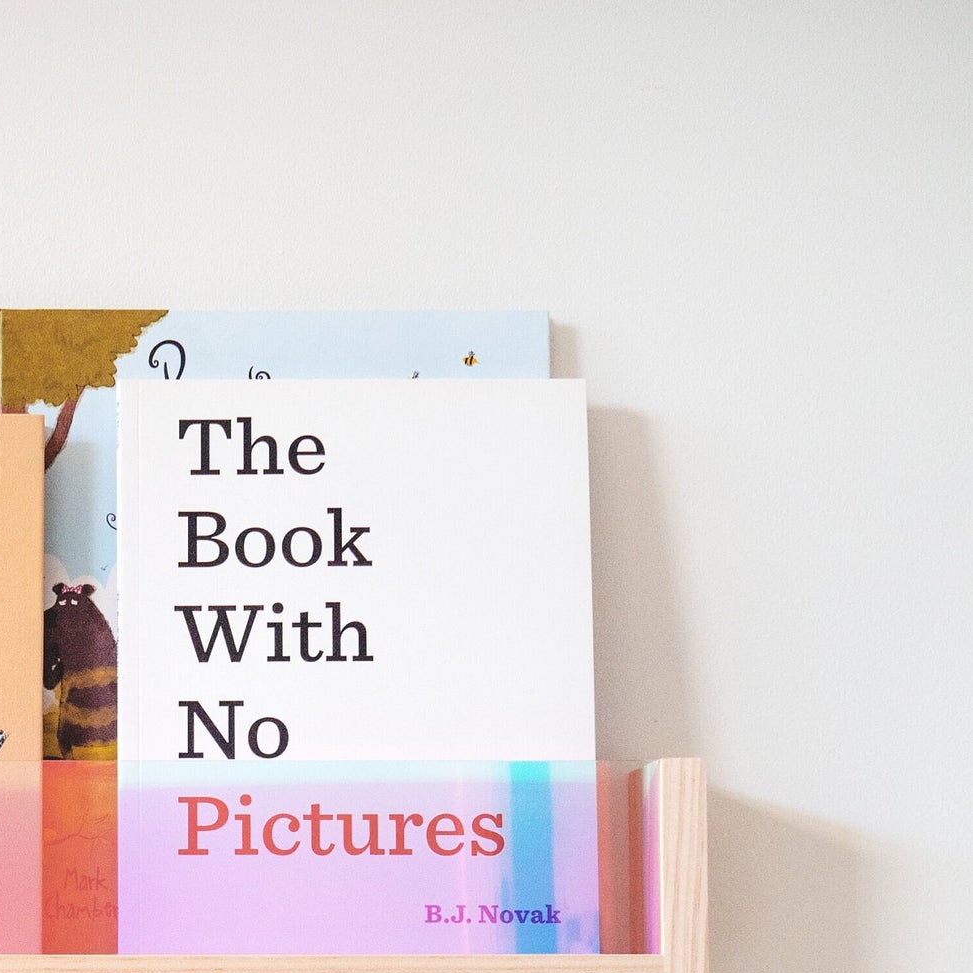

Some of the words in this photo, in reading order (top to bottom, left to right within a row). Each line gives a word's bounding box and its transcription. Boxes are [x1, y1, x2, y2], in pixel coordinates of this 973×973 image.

[178, 416, 327, 476] The
[177, 507, 373, 569] Book
[174, 602, 374, 664] With
[178, 700, 290, 760] No
[177, 793, 505, 857] Pictures
[63, 866, 107, 891] Mark
[424, 904, 472, 924] B.J.
[478, 904, 562, 925] Novak
